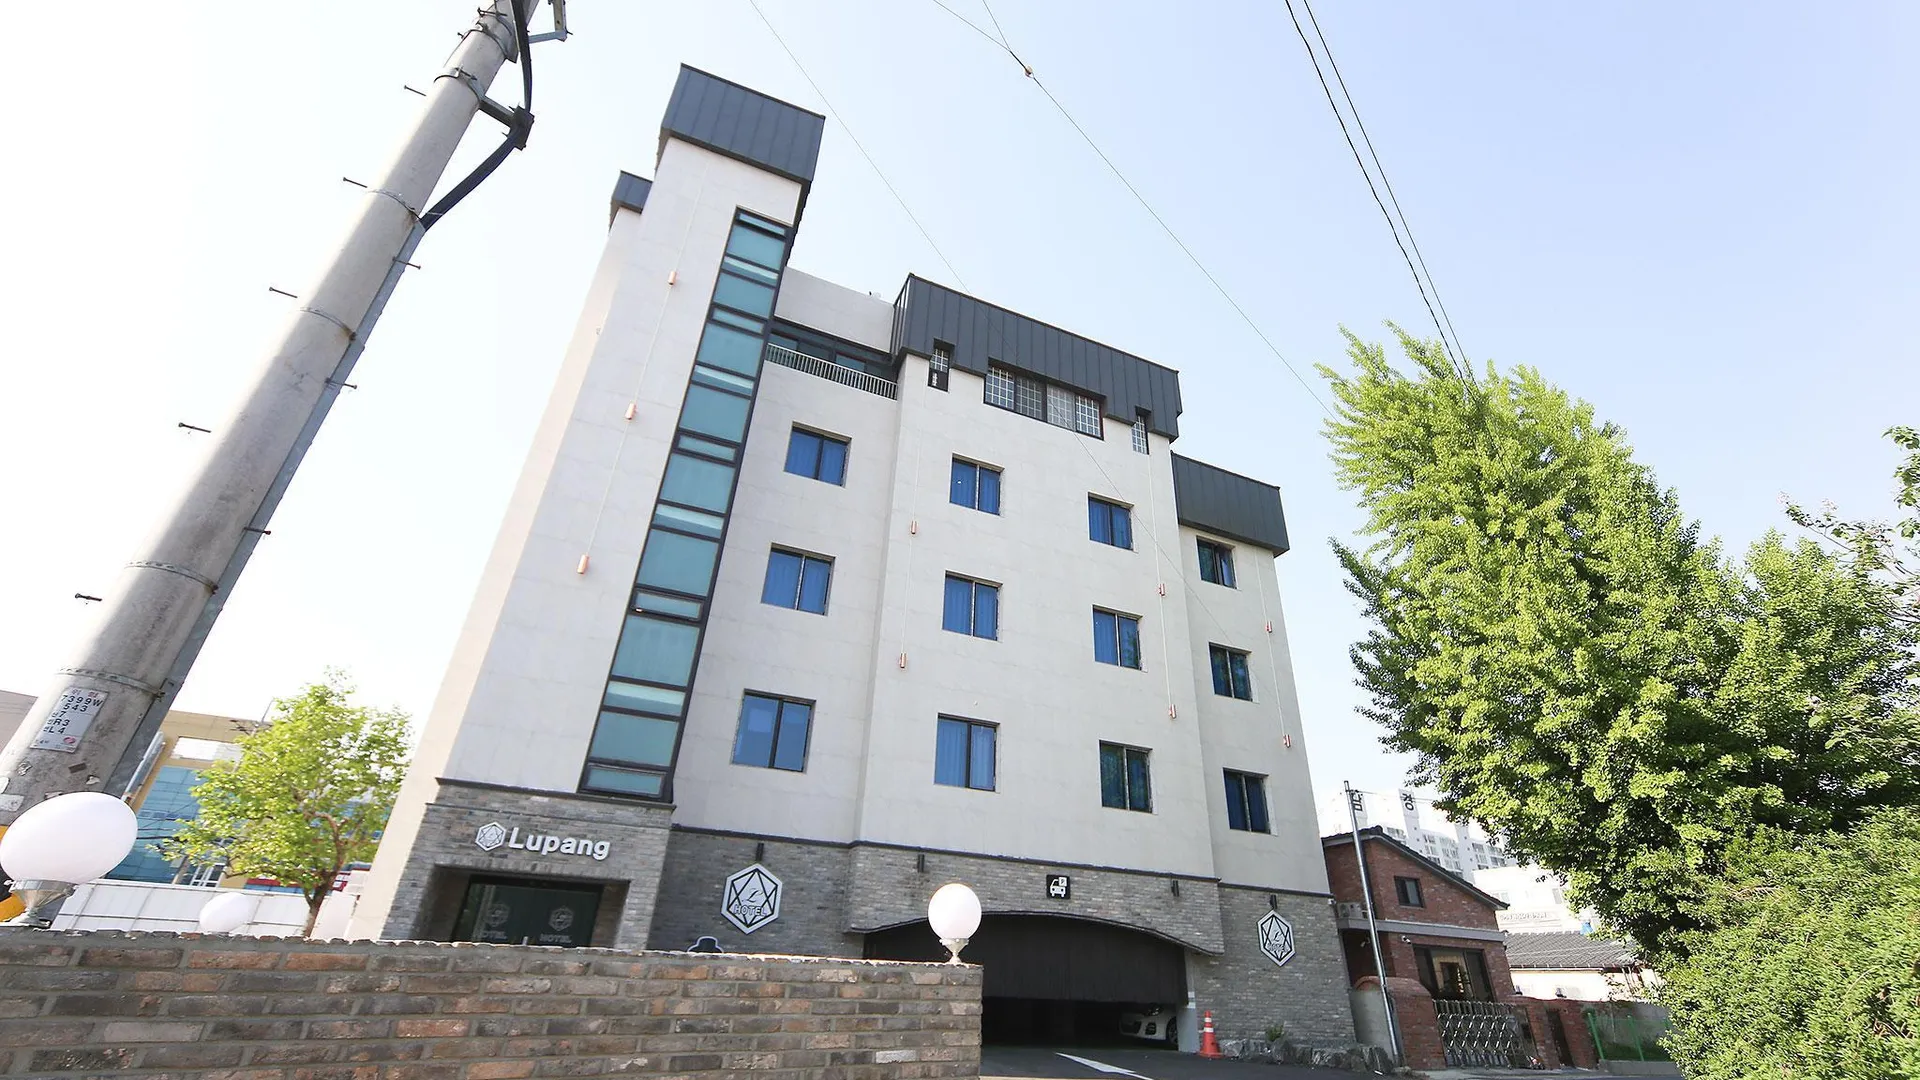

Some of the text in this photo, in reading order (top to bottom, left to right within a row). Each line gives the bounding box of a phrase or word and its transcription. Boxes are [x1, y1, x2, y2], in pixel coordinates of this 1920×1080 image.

[61, 694, 103, 707] 7399W
[63, 702, 88, 712] 543
[508, 826, 611, 861] Lupang
[733, 903, 768, 917] HOTEL
